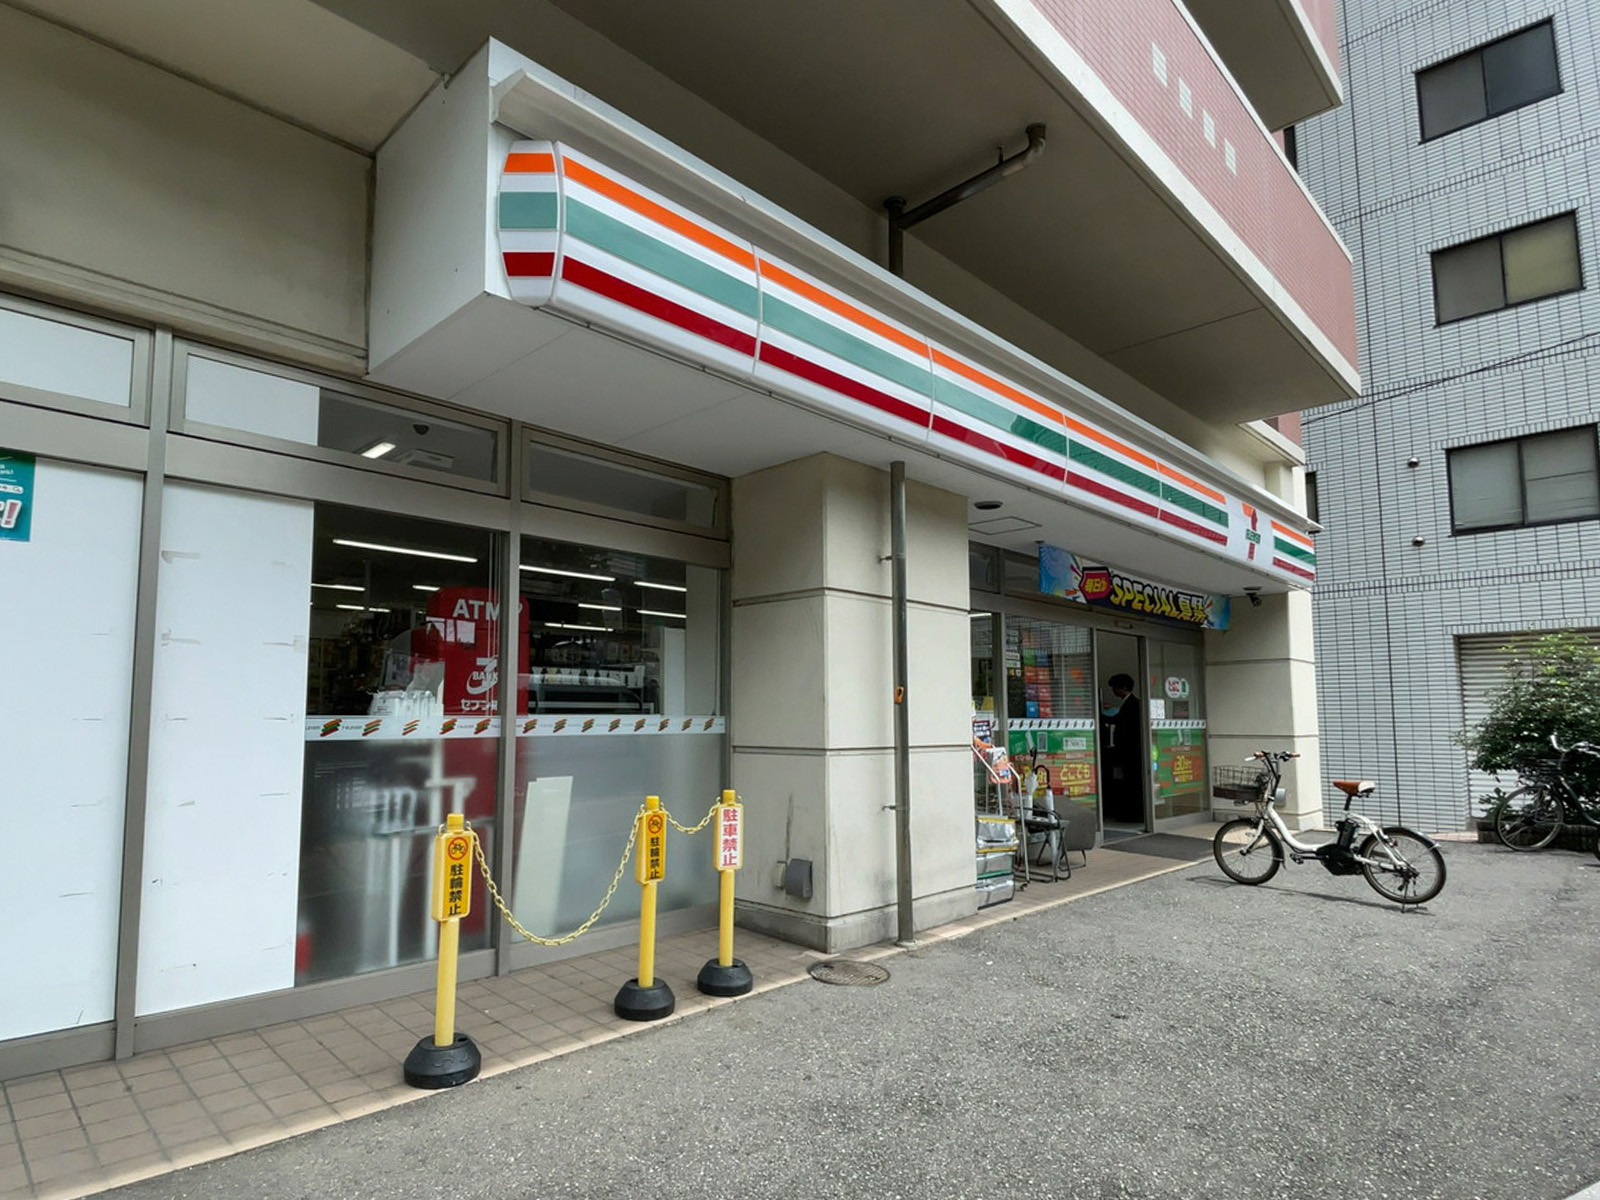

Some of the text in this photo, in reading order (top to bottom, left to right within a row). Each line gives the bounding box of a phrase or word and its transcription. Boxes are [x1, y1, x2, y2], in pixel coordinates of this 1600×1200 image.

[452, 598, 500, 621] ATM
[650, 836, 660, 880] 駐輪禁止
[722, 808, 738, 867] 駐車禁止
[449, 863, 464, 917] 駐輪禁止
